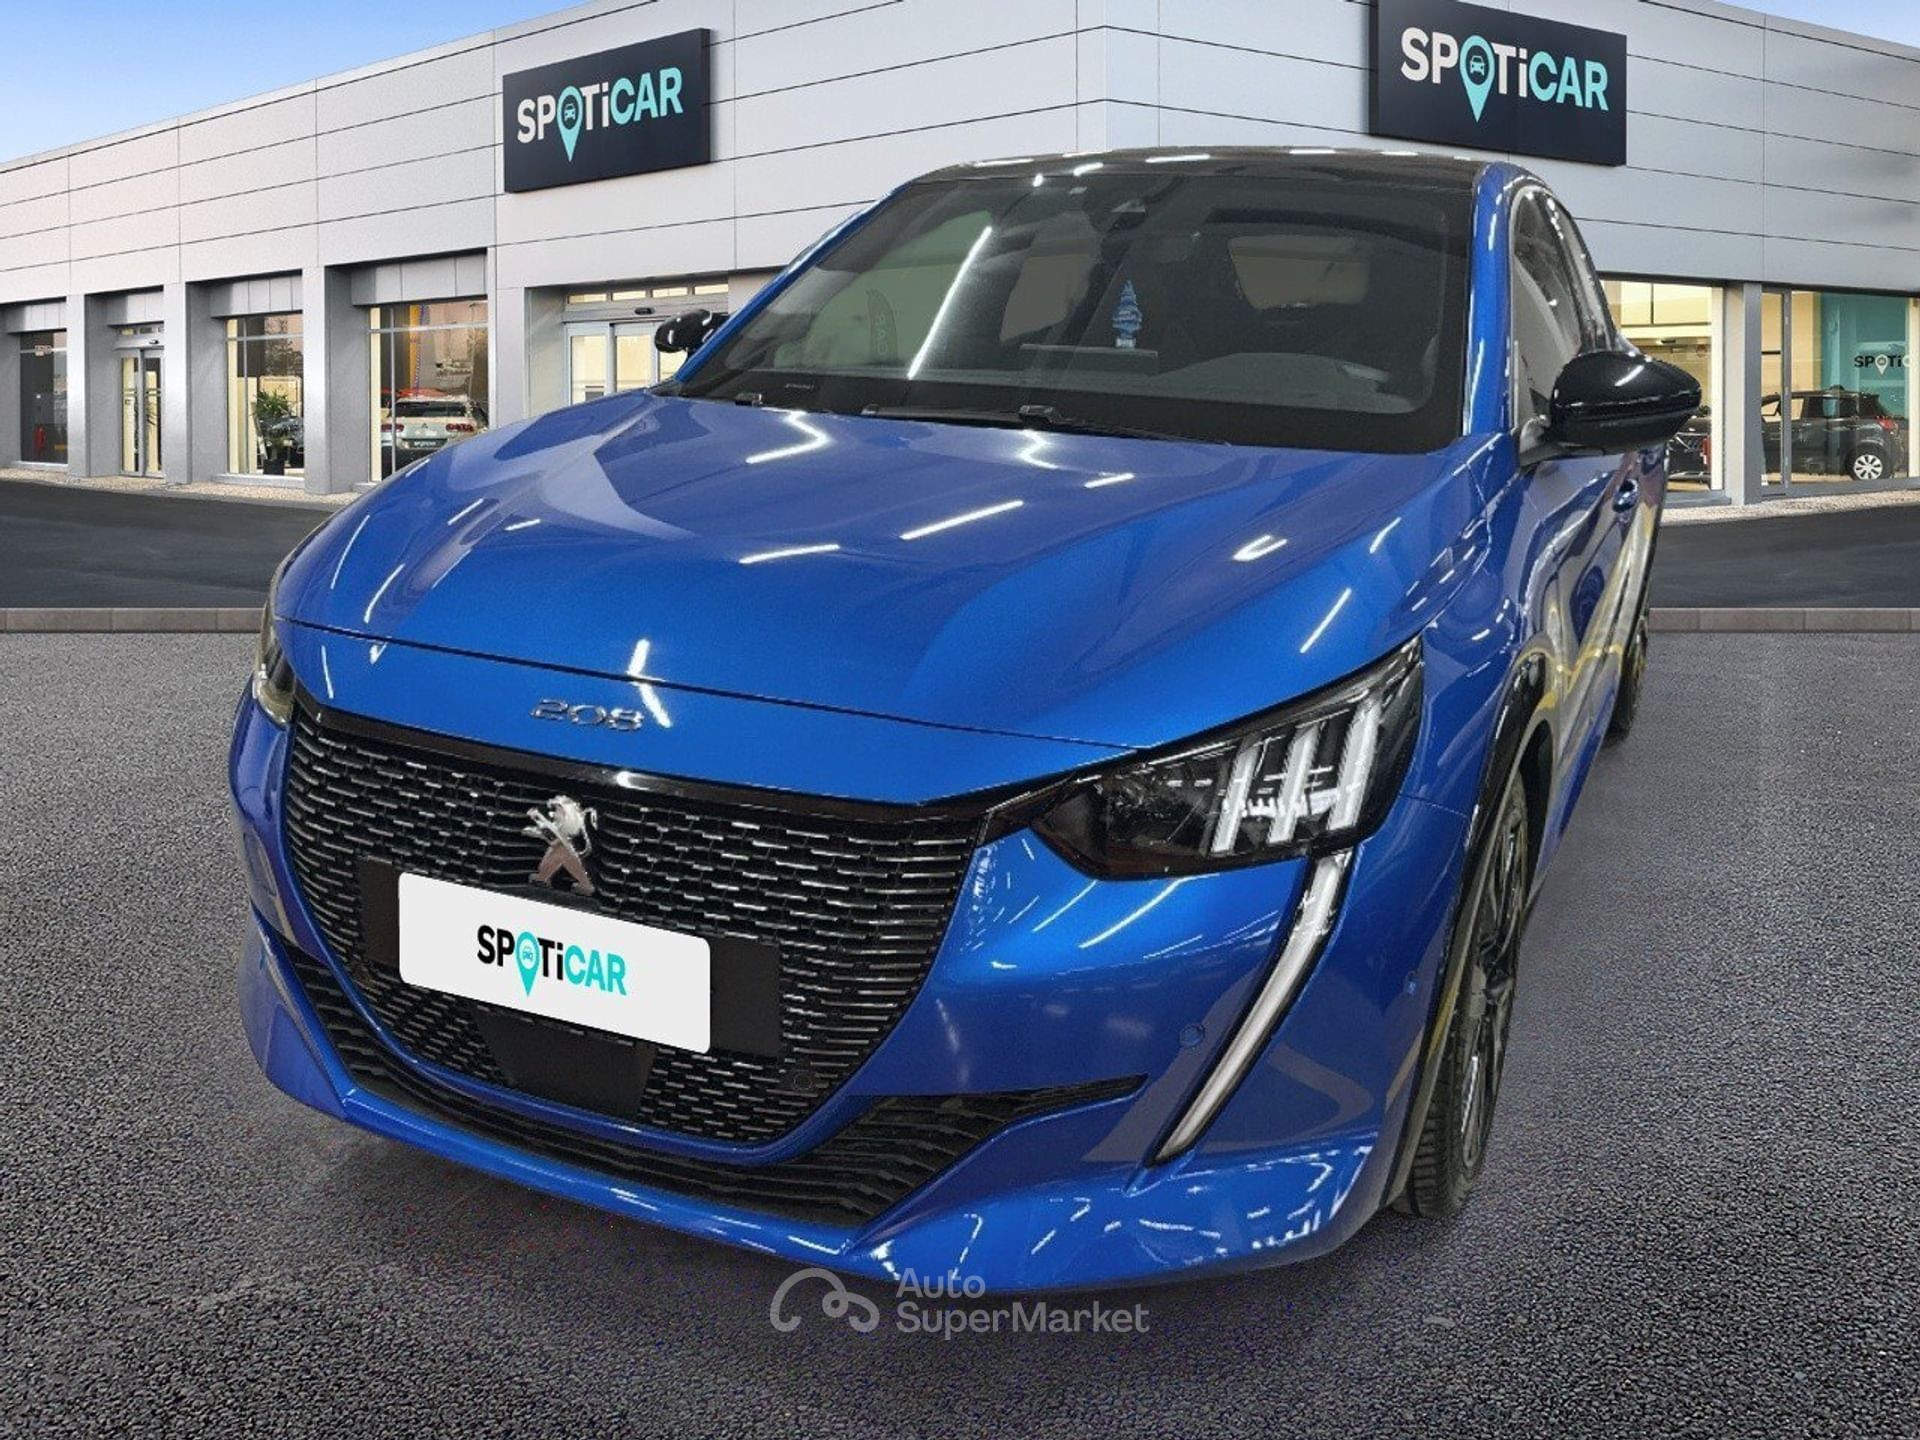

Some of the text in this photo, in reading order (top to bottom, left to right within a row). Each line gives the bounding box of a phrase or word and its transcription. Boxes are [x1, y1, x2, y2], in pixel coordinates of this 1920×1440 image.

[517, 66, 684, 162] SPOTiCAR
[1401, 26, 1609, 123] SPOTiCAR
[529, 698, 646, 732] 208
[477, 924, 627, 997] SPOTiCAR
